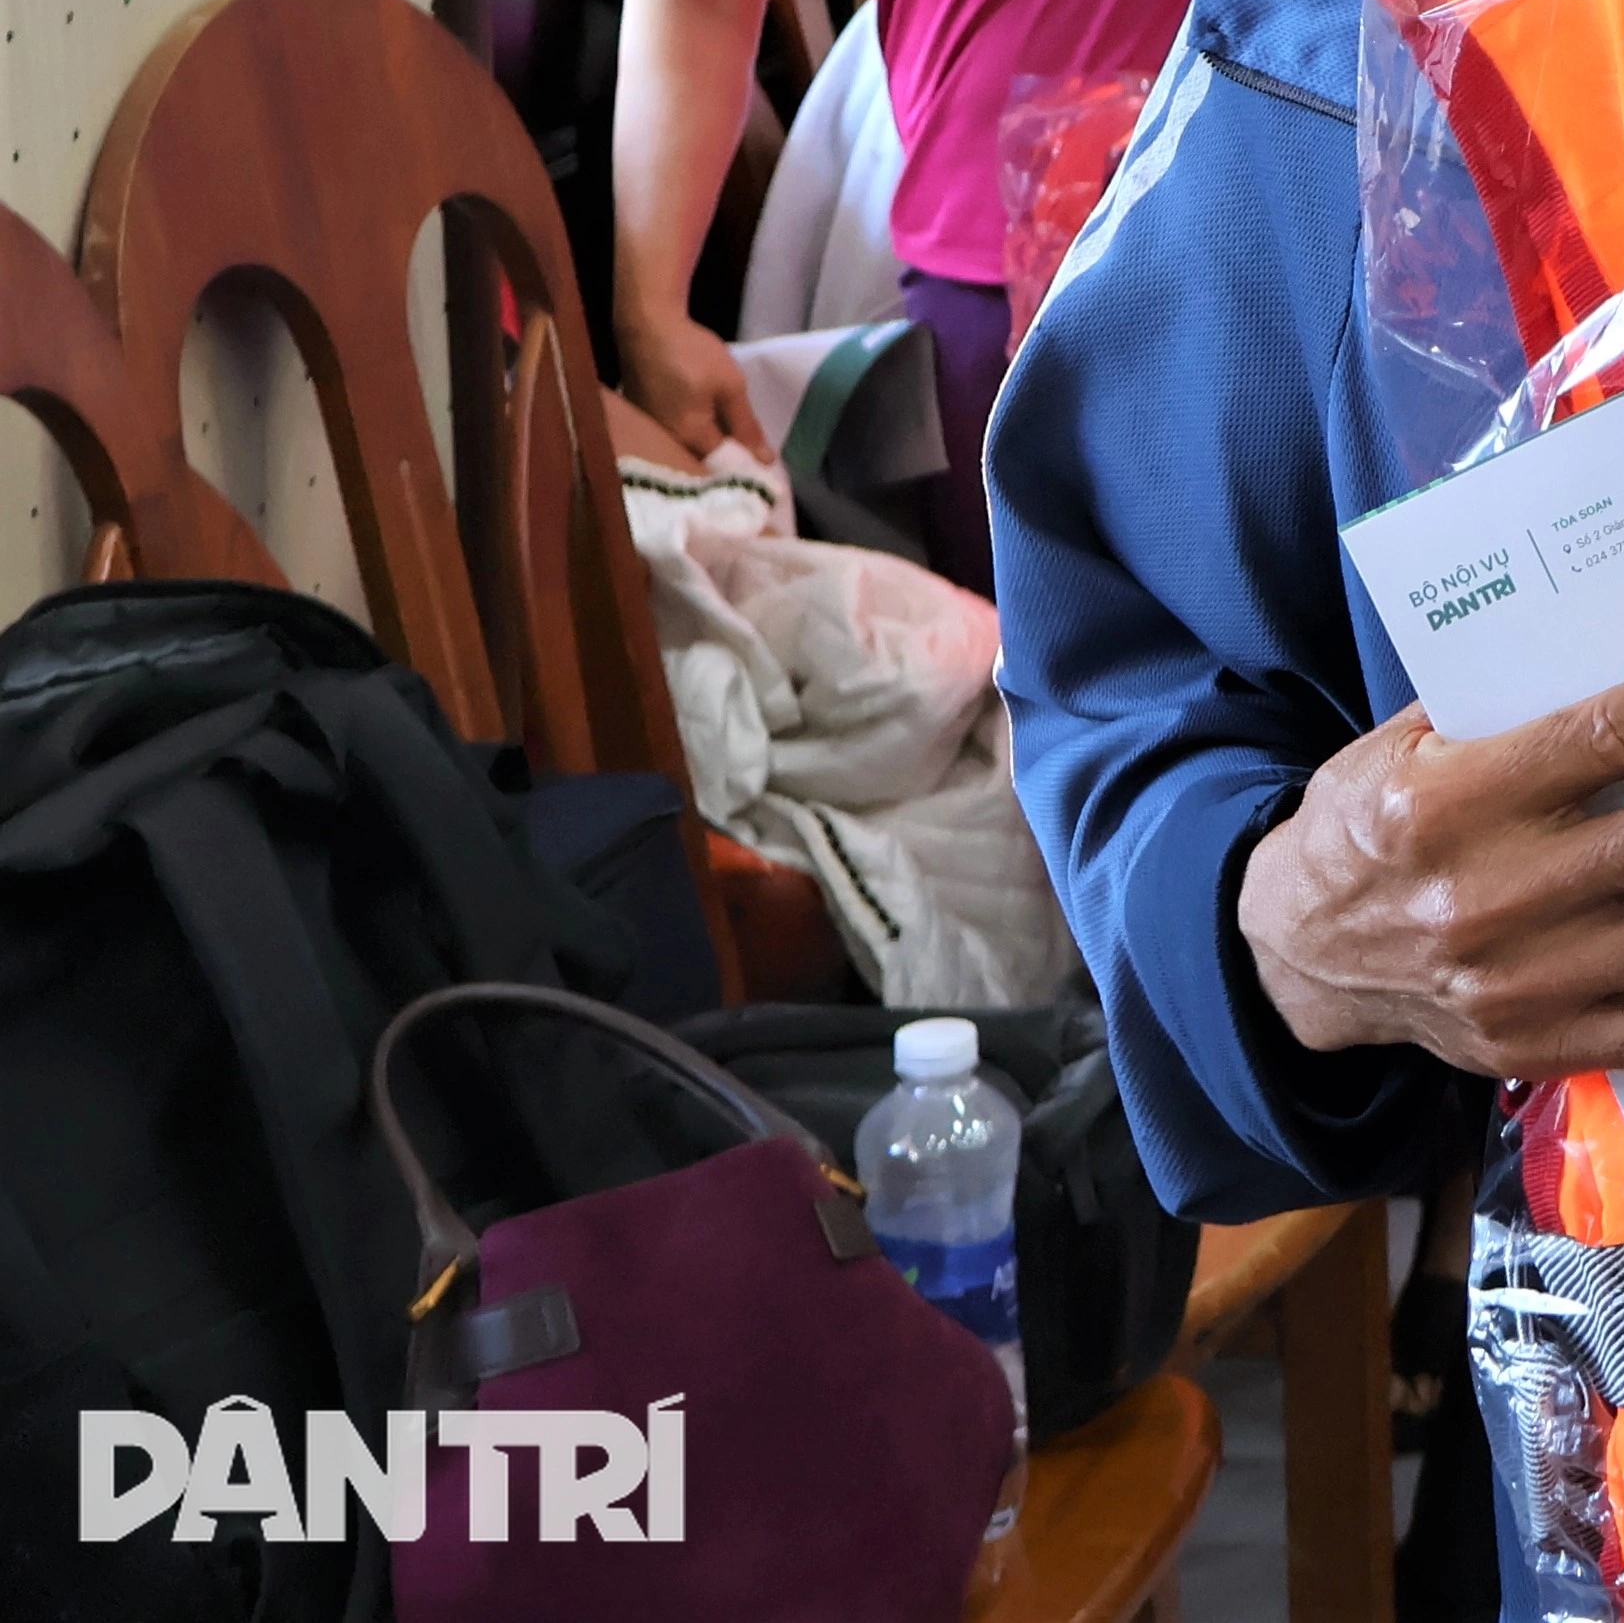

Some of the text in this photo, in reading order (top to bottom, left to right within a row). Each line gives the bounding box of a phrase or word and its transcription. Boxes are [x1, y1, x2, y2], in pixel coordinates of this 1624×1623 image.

[1593, 530, 1601, 541] 2
[1586, 551, 1607, 568] 024
[1408, 547, 1510, 608] BỘ NỘI VỤ
